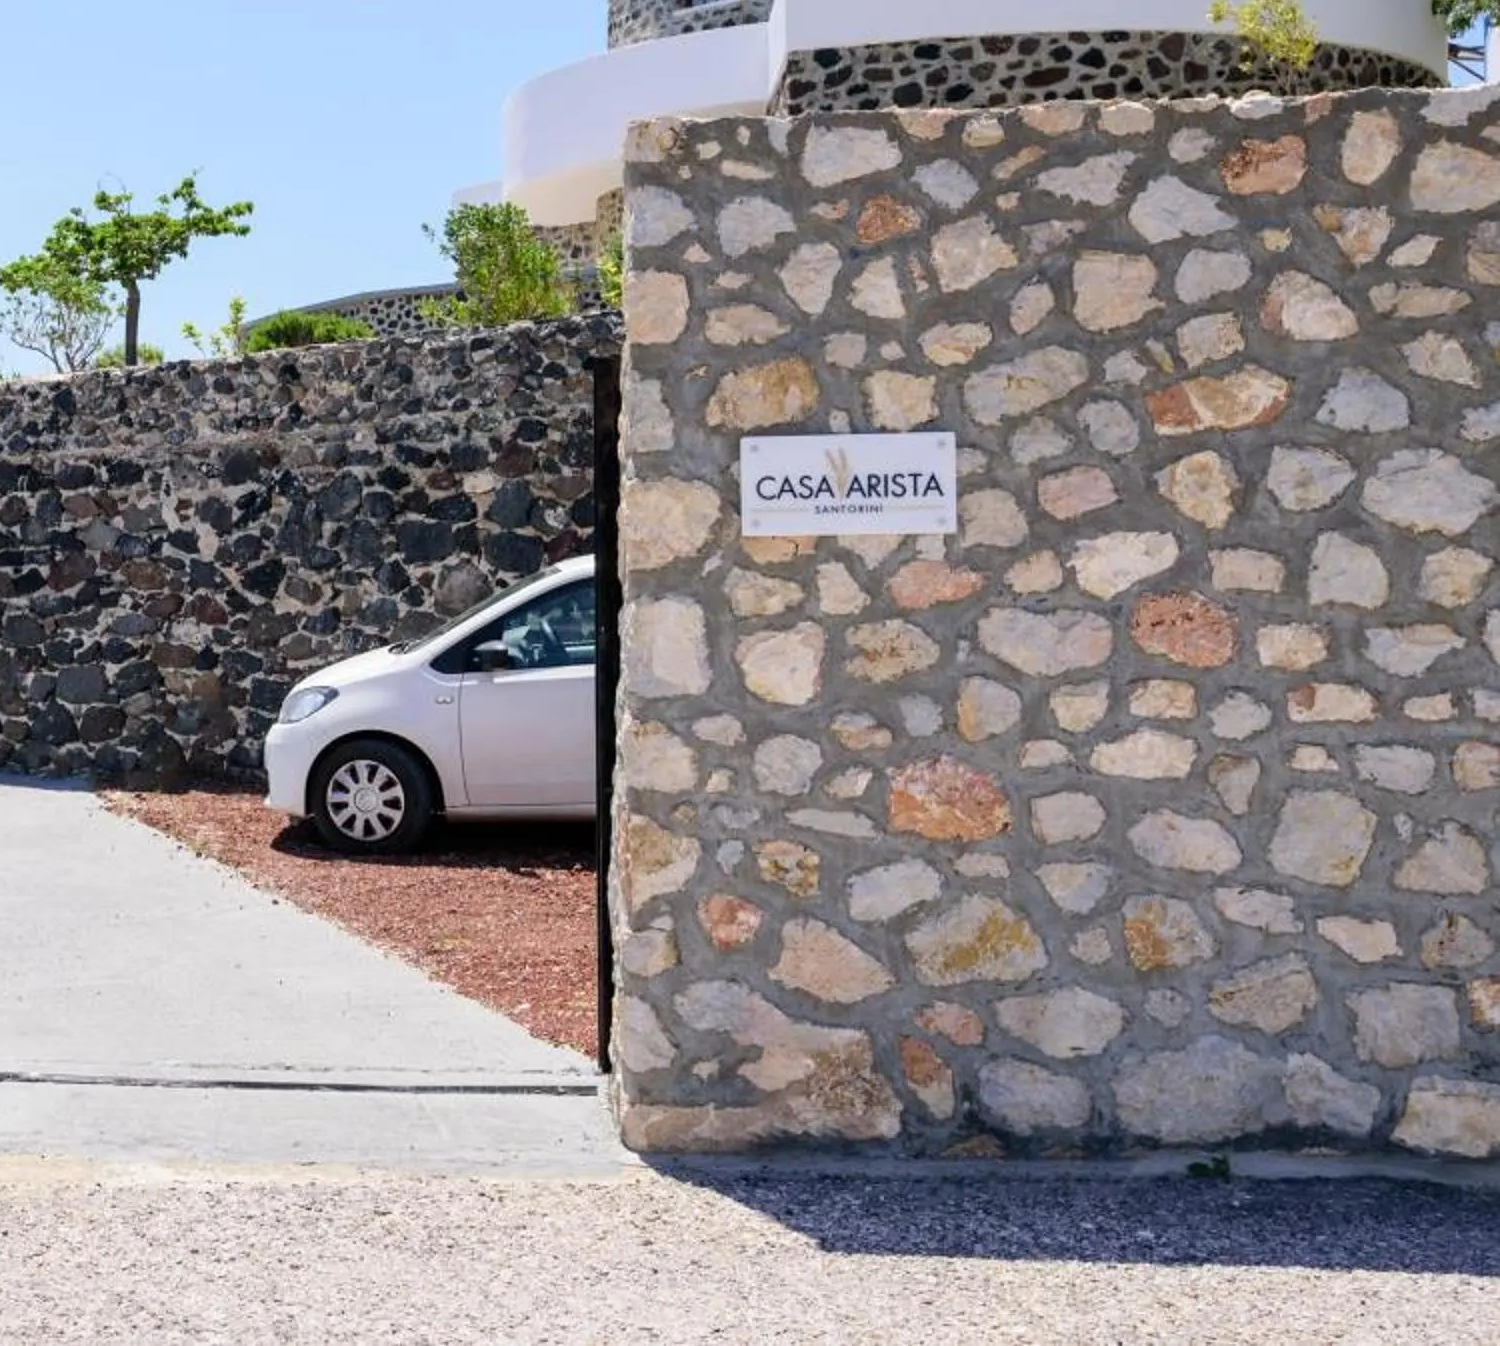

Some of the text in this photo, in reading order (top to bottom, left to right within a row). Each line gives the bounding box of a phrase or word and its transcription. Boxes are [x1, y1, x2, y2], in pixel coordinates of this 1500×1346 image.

[756, 472, 944, 500] CASA ARISTA
[815, 504, 883, 515] SANTORINI
